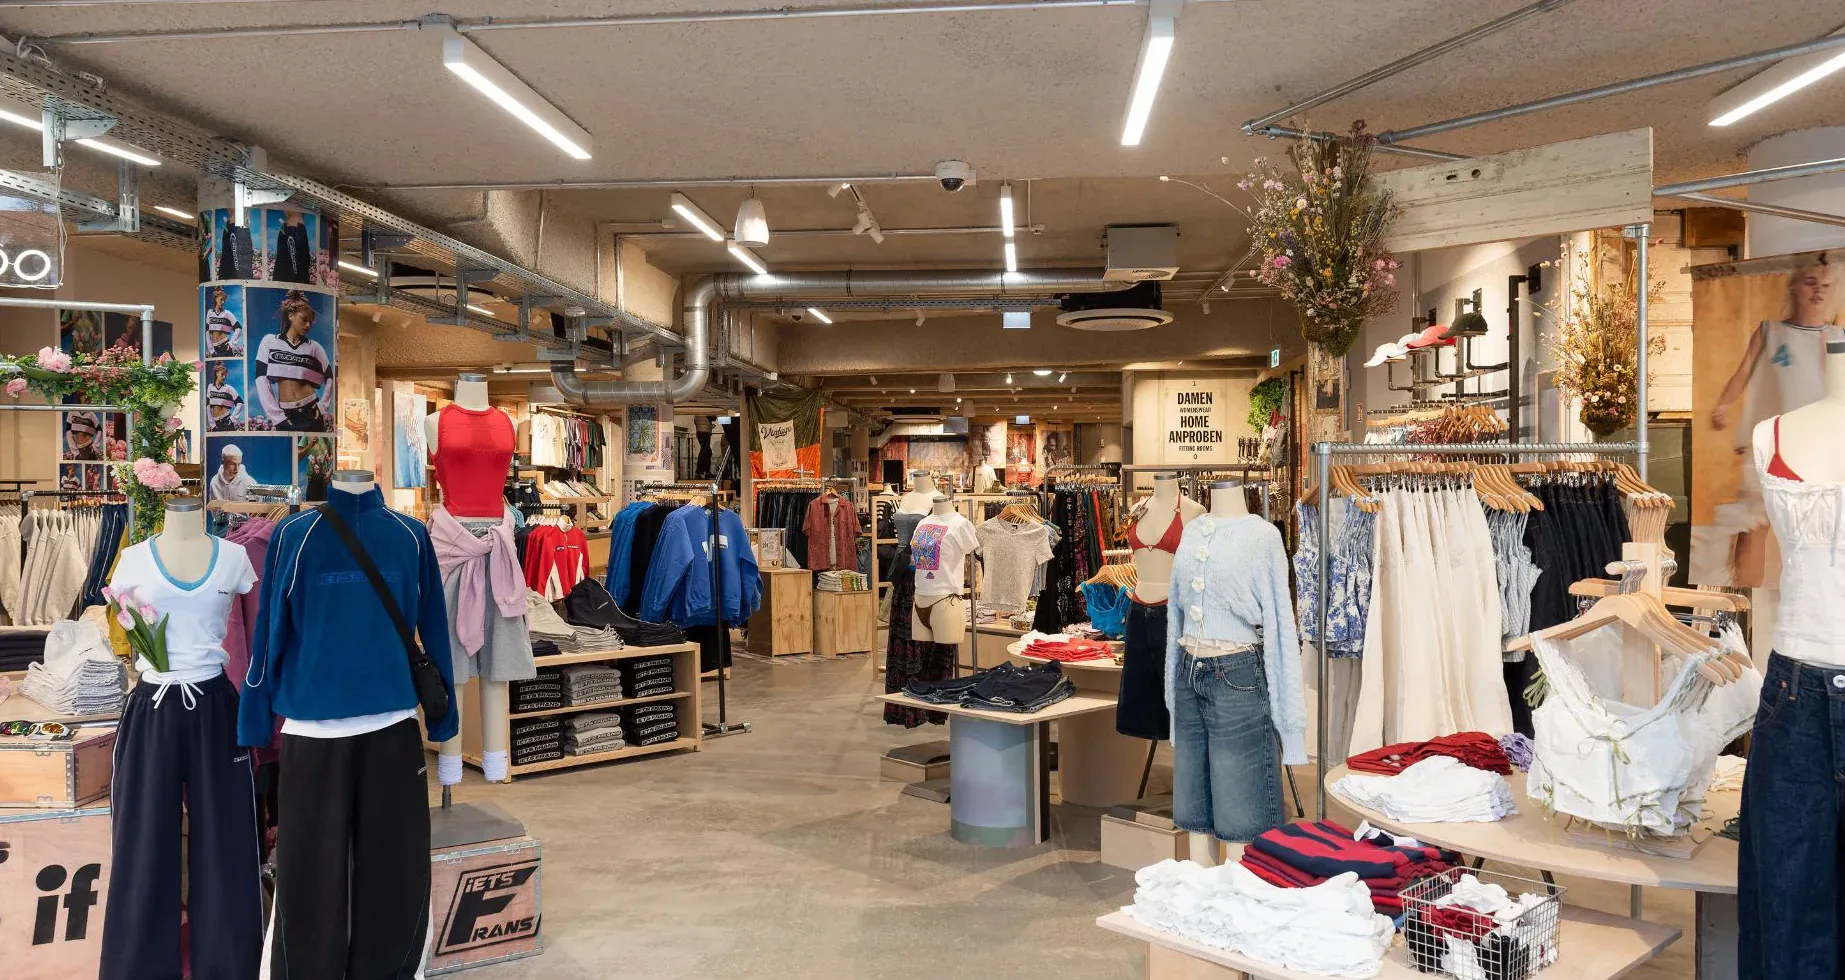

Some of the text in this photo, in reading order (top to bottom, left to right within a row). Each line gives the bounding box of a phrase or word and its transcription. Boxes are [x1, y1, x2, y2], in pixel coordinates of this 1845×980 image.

[1177, 392, 1213, 405] DAMEN
[1180, 415, 1210, 428] HOME
[1168, 430, 1223, 443] ANPROBEN
[32, 863, 102, 946] if
